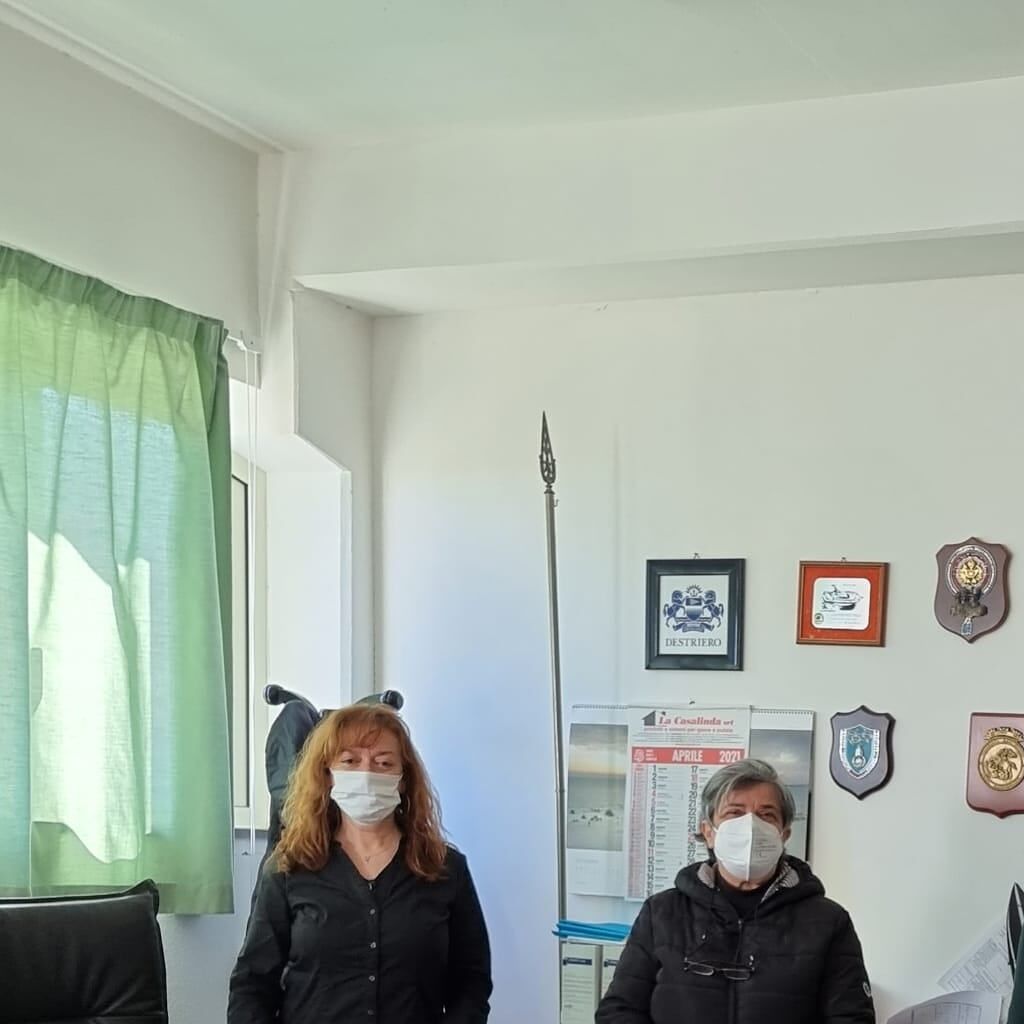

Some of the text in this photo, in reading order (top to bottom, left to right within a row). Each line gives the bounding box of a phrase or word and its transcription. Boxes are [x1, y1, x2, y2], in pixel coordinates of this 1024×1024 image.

[665, 637, 722, 647] DESTRIERO
[658, 715, 671, 726] La
[674, 715, 721, 726] Casalinda
[672, 749, 703, 762] APRILE
[719, 750, 741, 763] 2021
